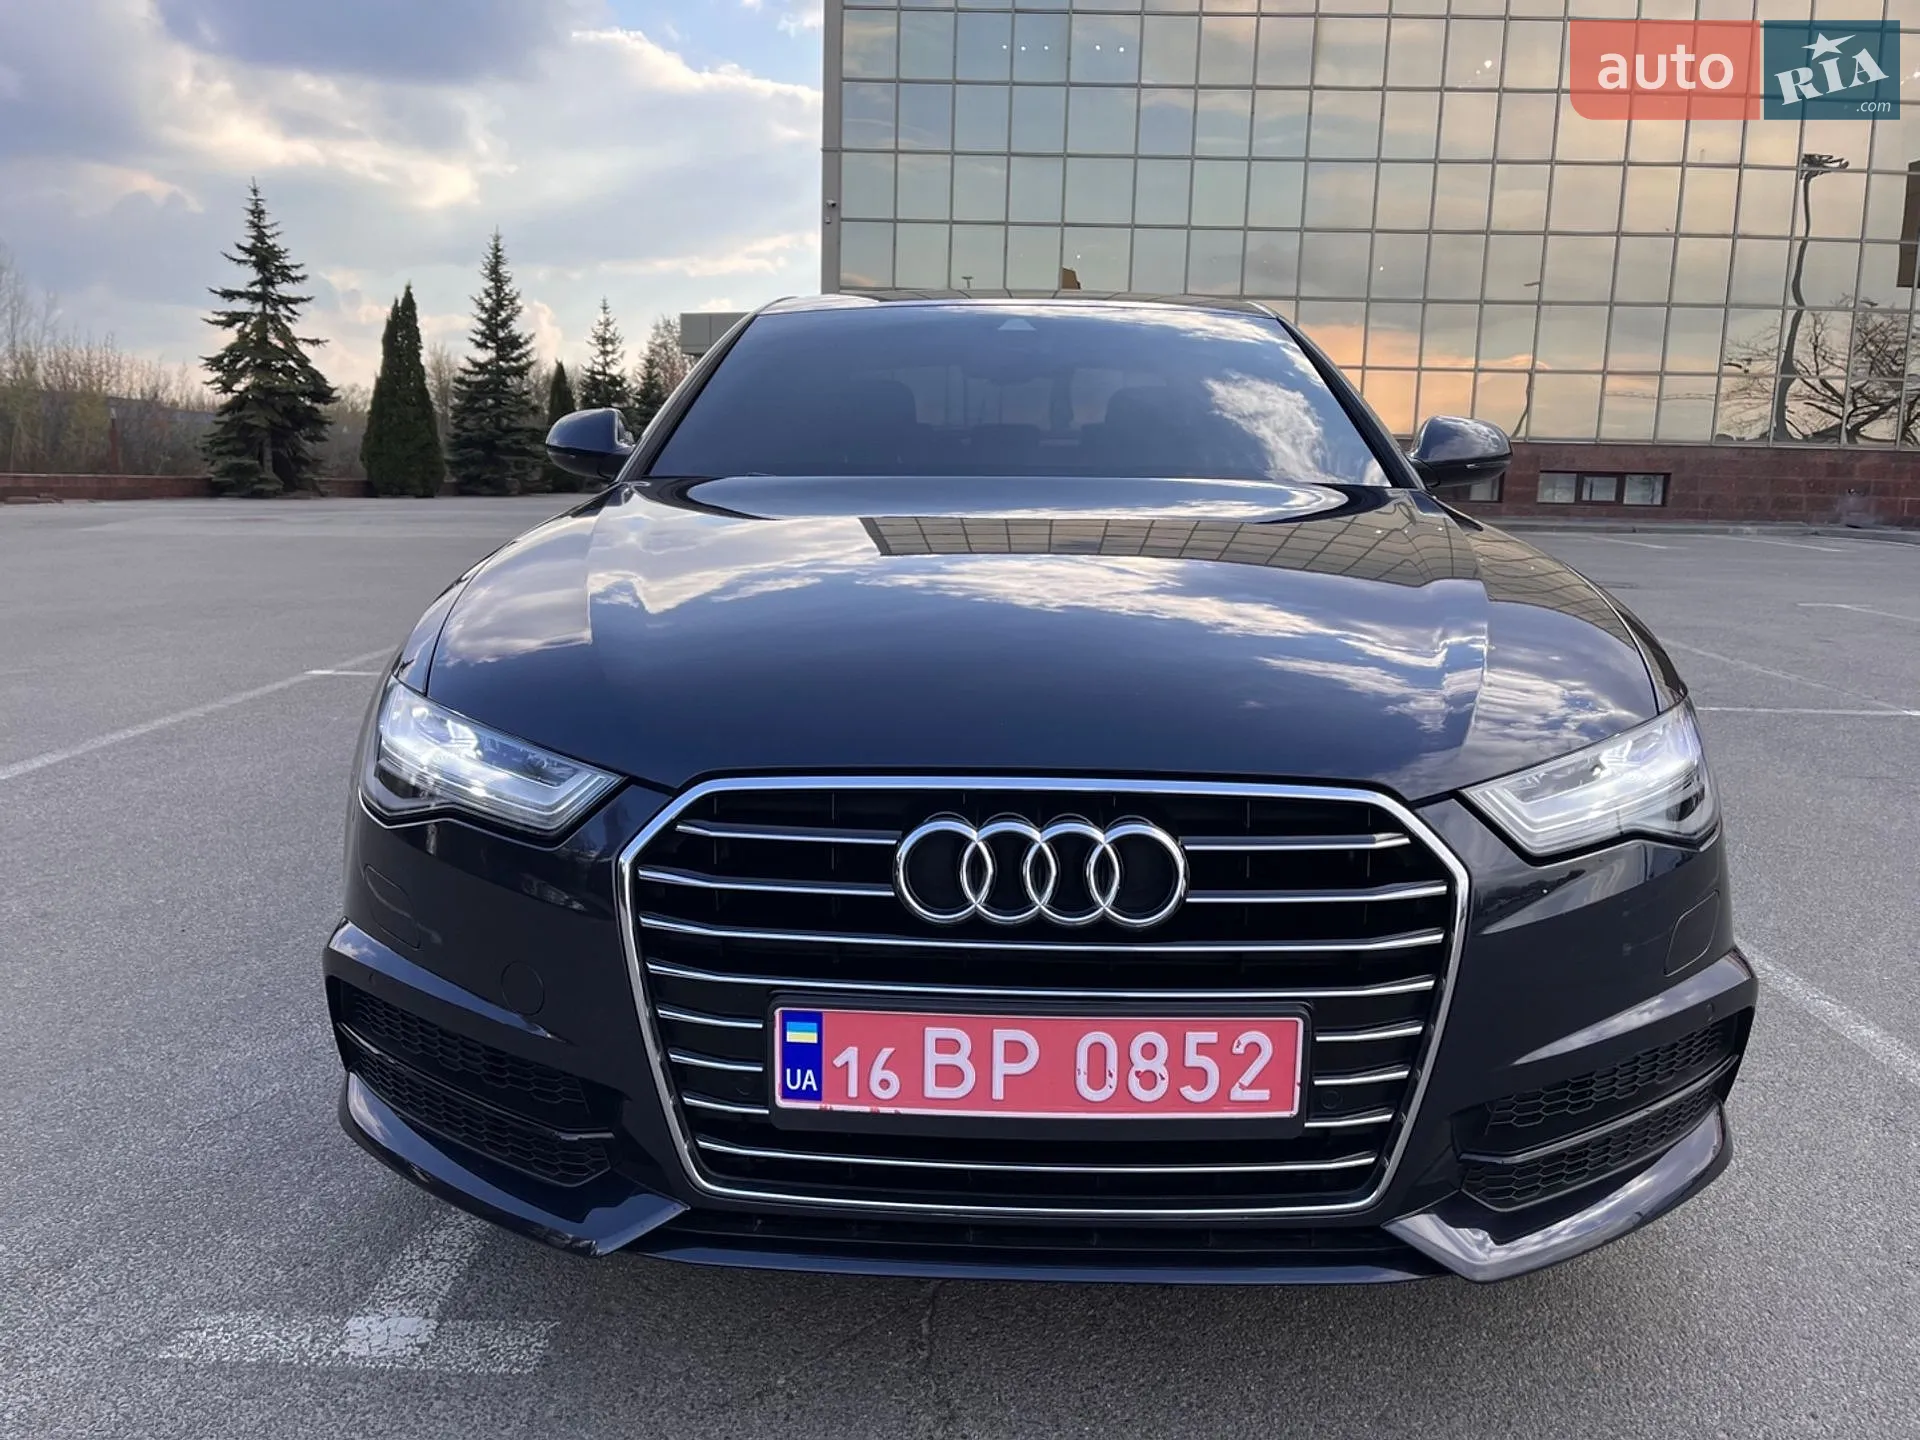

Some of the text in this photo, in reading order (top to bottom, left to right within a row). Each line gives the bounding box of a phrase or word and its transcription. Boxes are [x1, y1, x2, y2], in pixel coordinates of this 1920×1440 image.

[786, 1068, 818, 1092] UA
[832, 1026, 1274, 1103] 16 BP 0852
